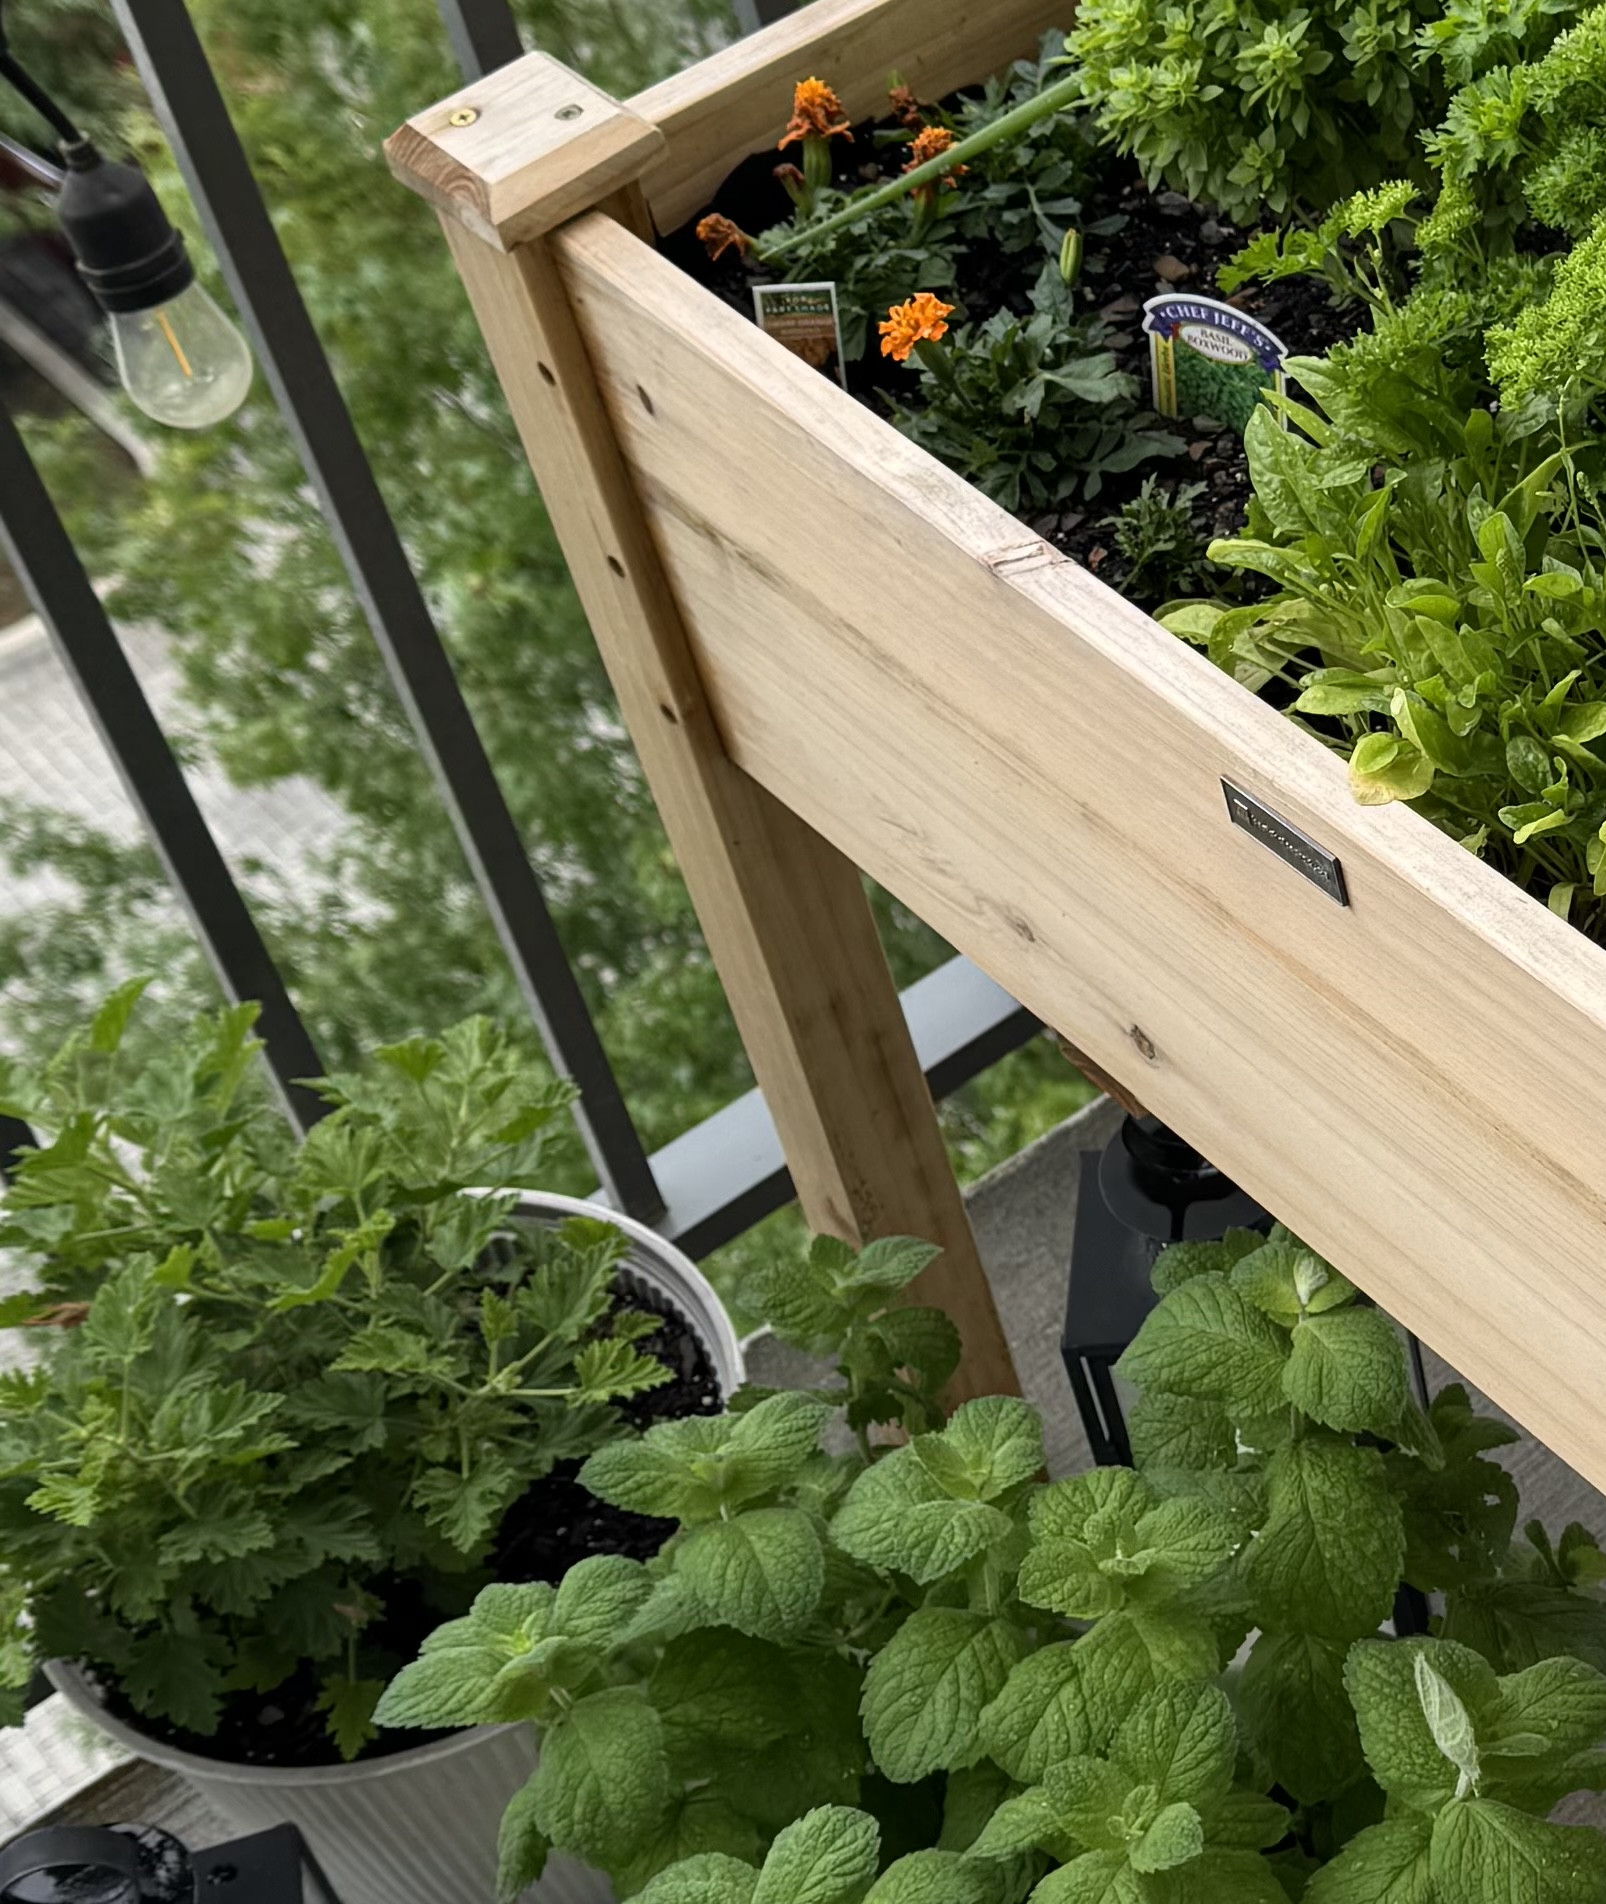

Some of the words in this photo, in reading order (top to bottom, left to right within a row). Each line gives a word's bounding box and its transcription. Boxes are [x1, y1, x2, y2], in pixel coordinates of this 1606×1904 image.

[1165, 304, 1209, 320] CHEF
[1214, 312, 1264, 348] JEFF'S
[1200, 328, 1233, 346] BASIL
[1187, 334, 1249, 360] BOXWOOD
